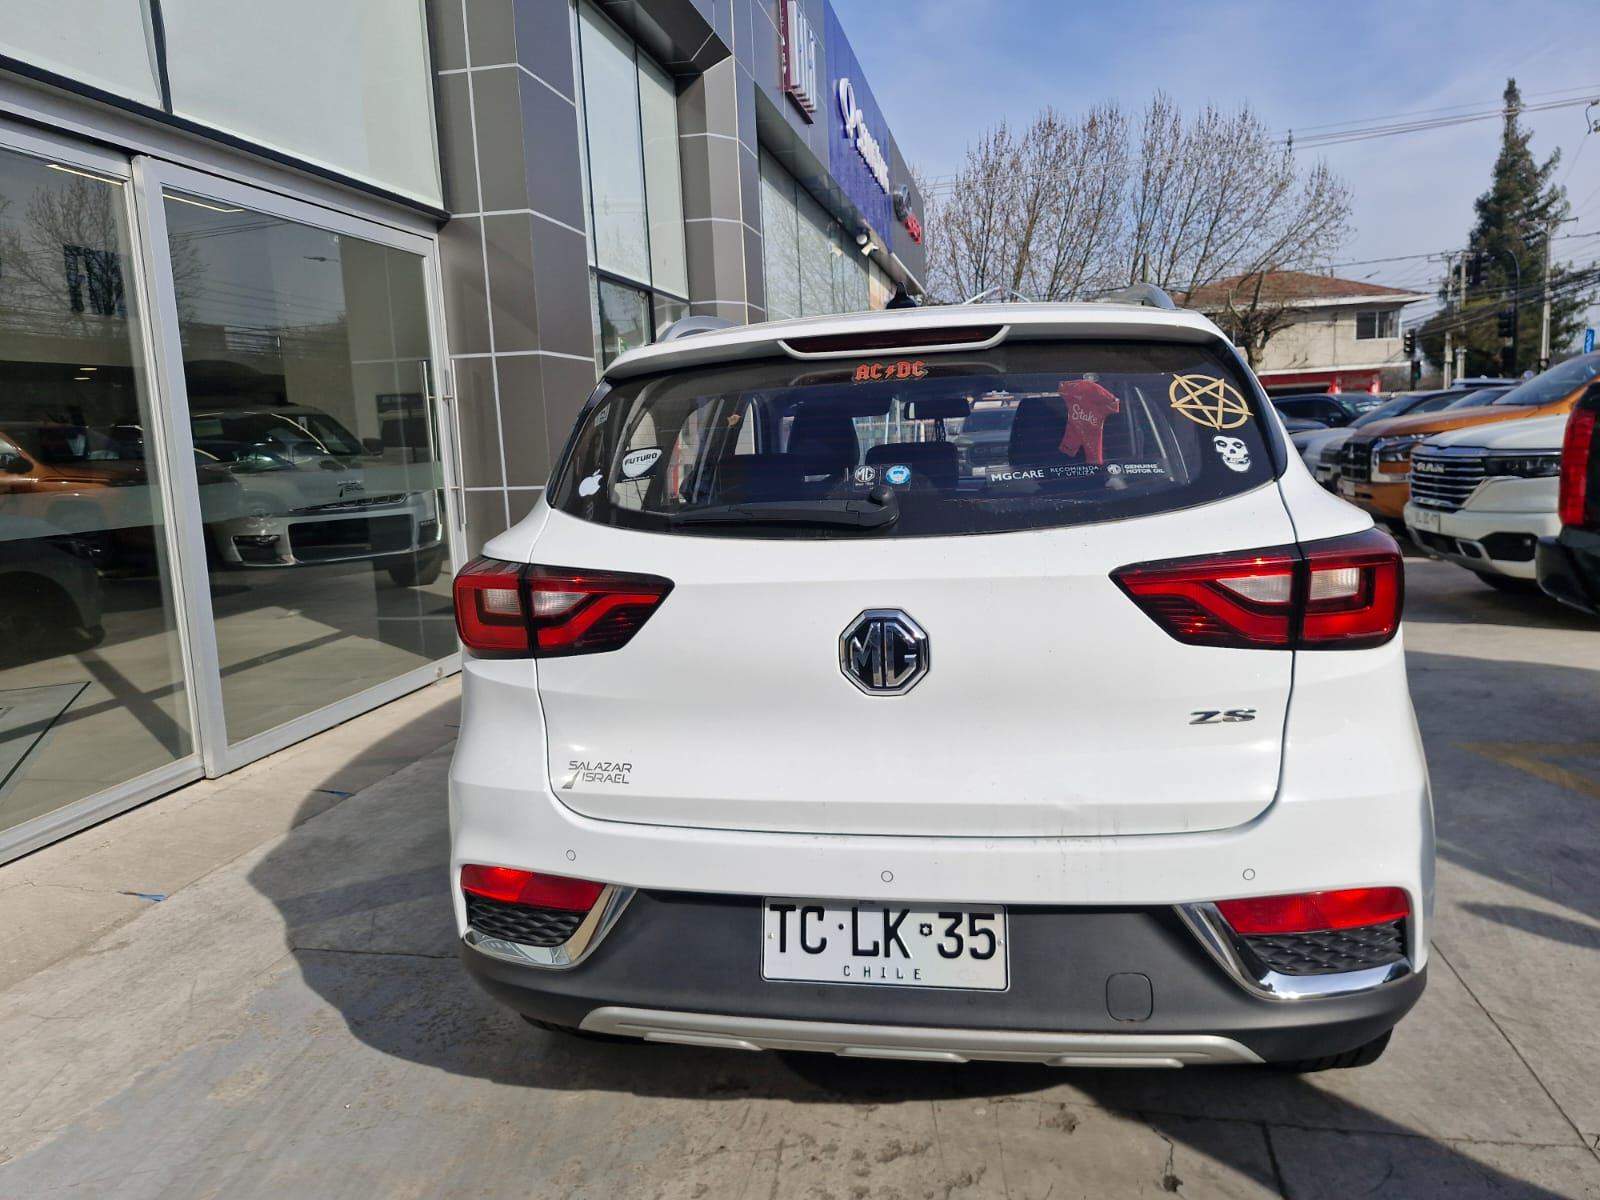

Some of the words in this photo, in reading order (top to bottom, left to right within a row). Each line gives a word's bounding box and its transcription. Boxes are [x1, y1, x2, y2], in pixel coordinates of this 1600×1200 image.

[1072, 404, 1098, 426] Stake
[856, 466, 875, 482] MG
[990, 469, 1045, 482] MGCARE
[847, 619, 920, 689] MG
[1188, 709, 1257, 725] ZS
[567, 760, 633, 773] SALAZAR
[581, 771, 630, 784] ISRAEL
[842, 964, 922, 981] CHILE
